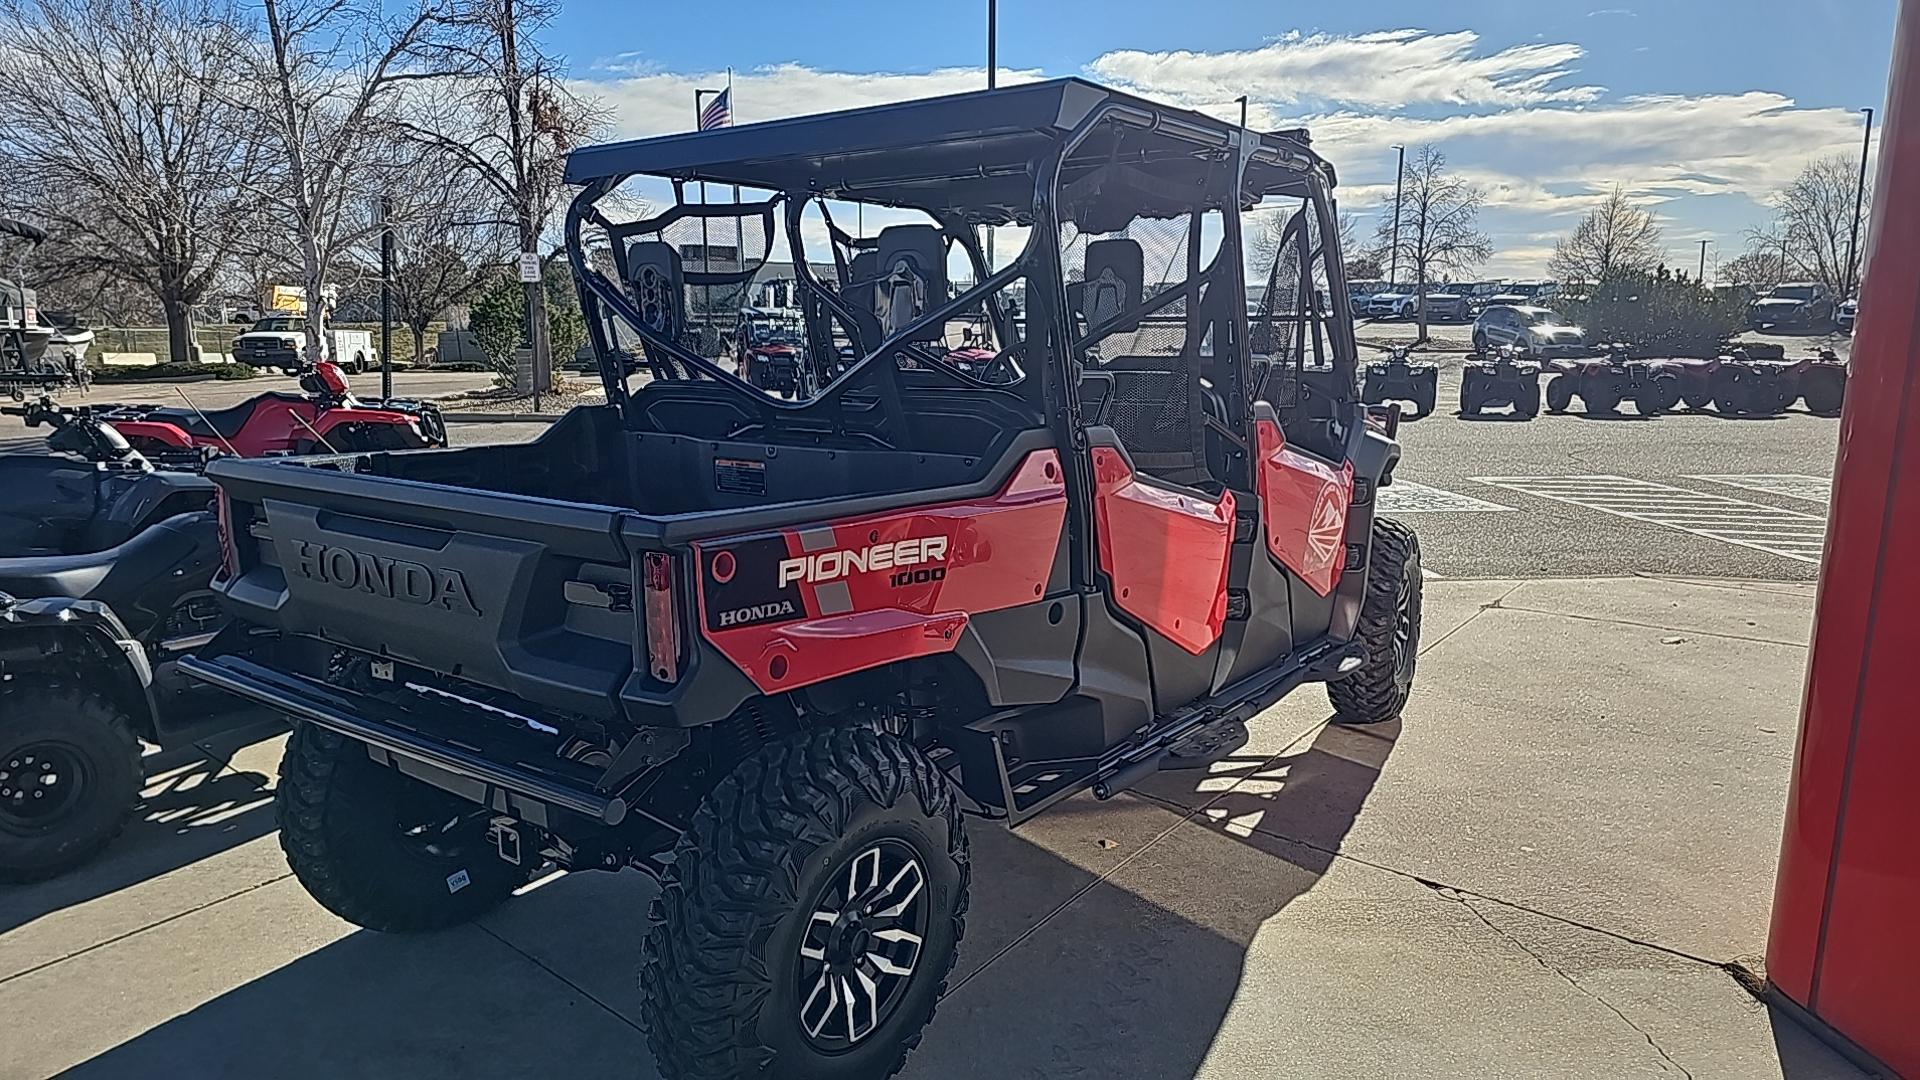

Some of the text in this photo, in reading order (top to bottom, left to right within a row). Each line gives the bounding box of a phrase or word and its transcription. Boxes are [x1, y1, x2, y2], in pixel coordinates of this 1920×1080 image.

[290, 539, 483, 617] HONDA
[777, 535, 949, 589] PIONEER
[888, 566, 947, 588] 1000
[718, 600, 796, 627] HONDA
